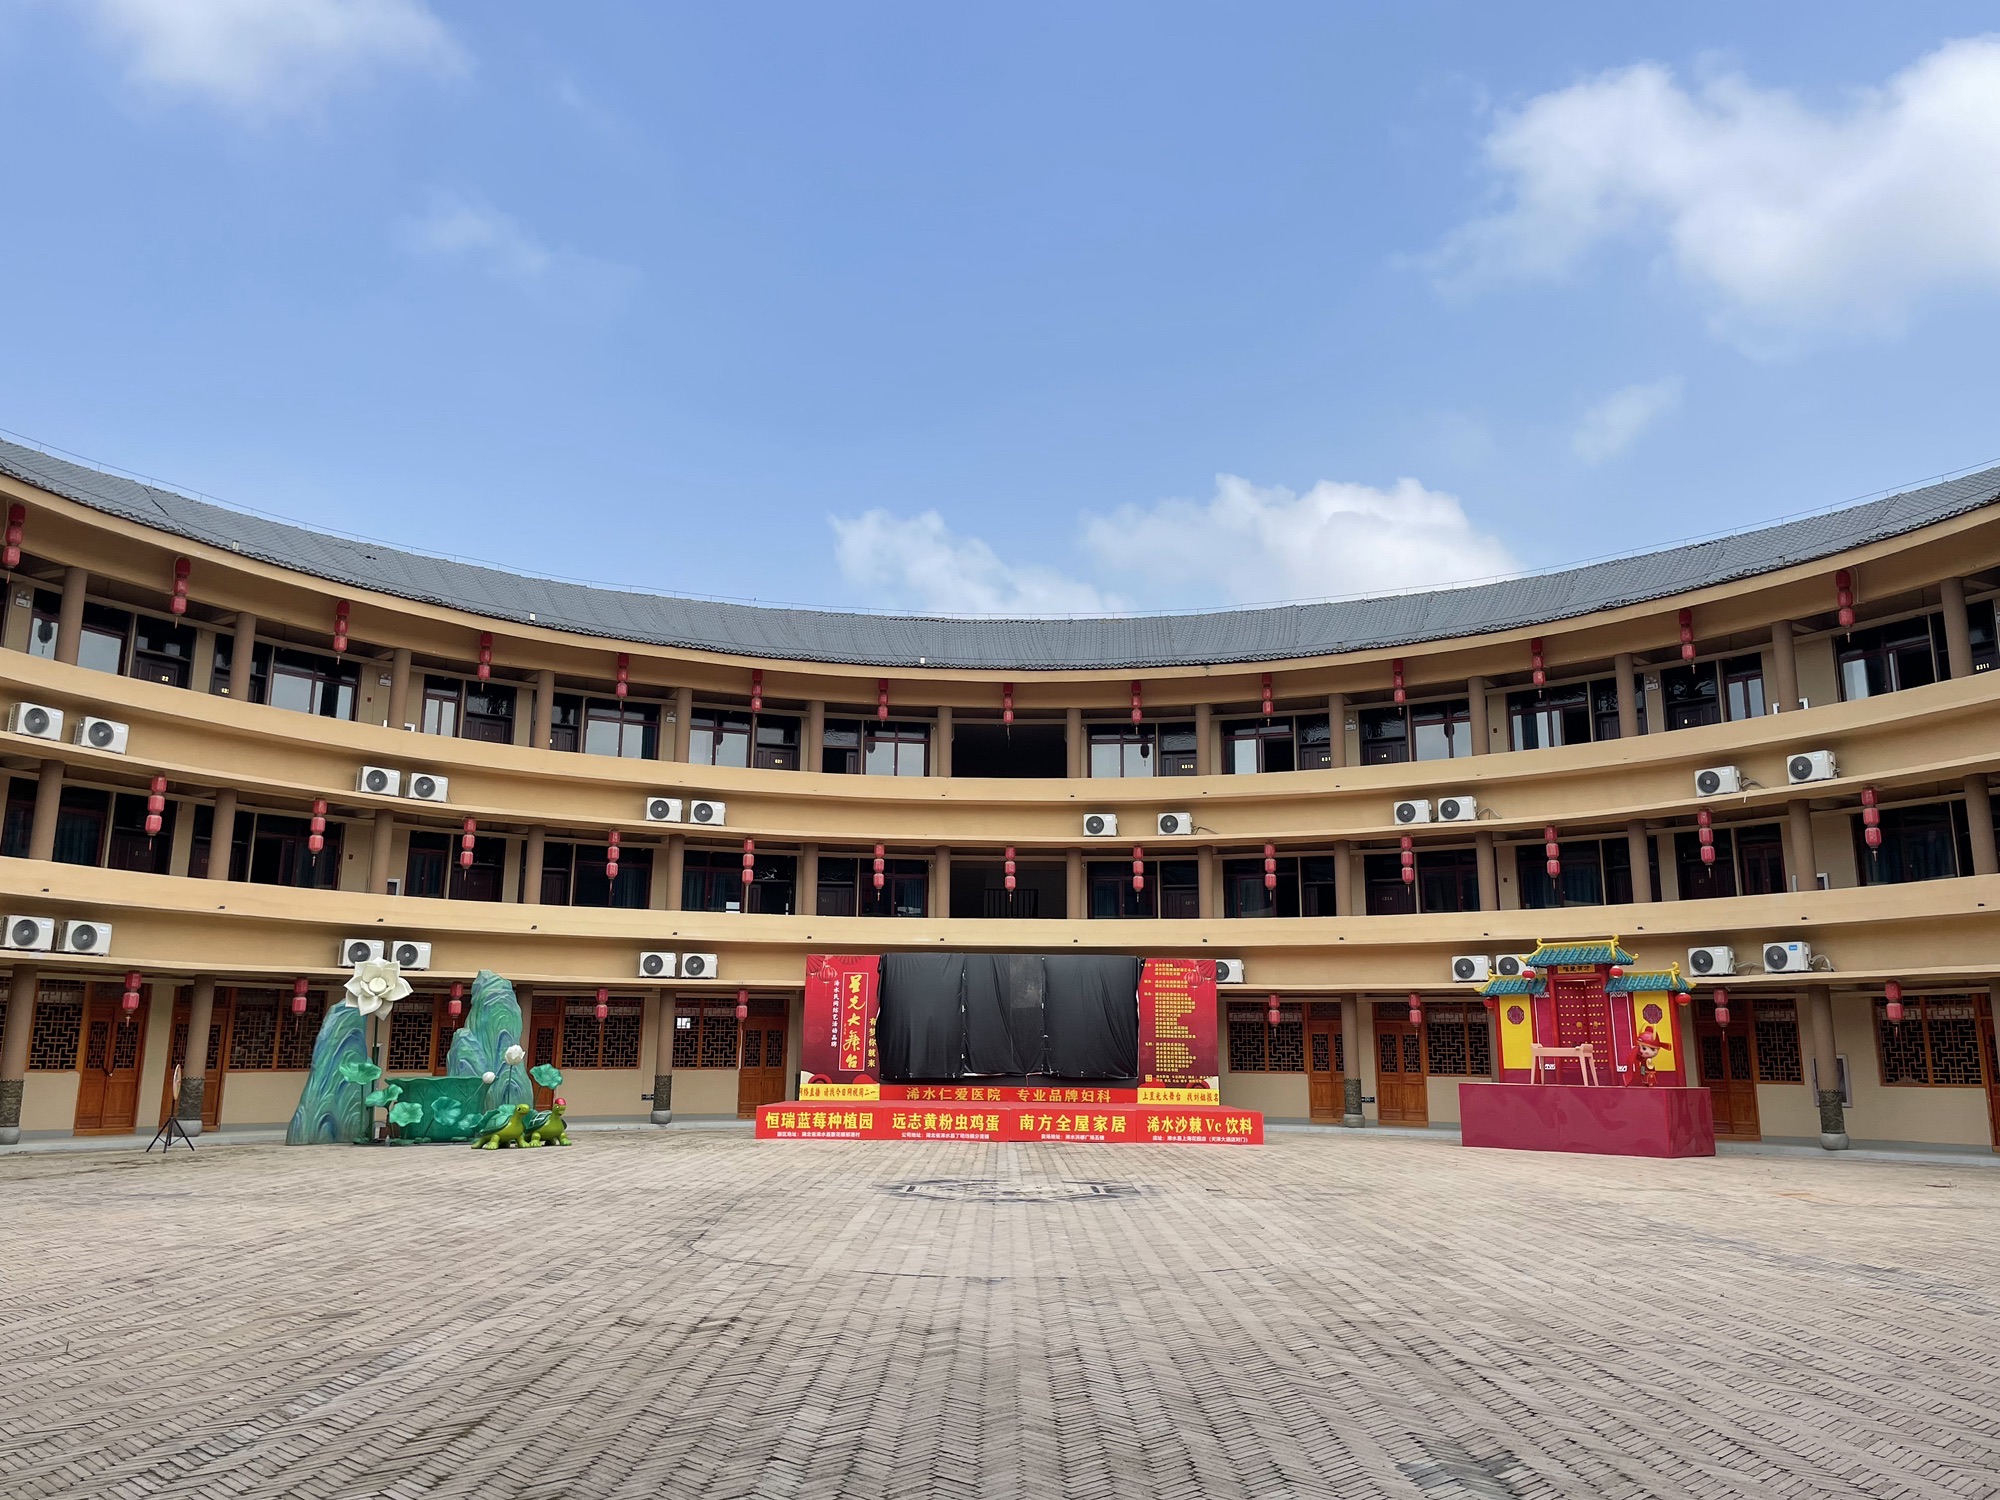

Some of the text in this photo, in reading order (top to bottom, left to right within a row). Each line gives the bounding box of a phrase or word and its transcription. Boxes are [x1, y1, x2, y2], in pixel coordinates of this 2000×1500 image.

[842, 974, 866, 1069] 星光大舞台
[906, 1087, 1111, 1104] 浠水仁爱医院 专业品牌妇科
[765, 1111, 874, 1130] 恒瑞蓝莓种植园
[892, 1113, 1000, 1132] 远志黄粉虫鸡蛋
[1019, 1113, 1127, 1133] 南方全屋家居
[1147, 1115, 1253, 1135] 浠水沙棘 Vc 饮料
